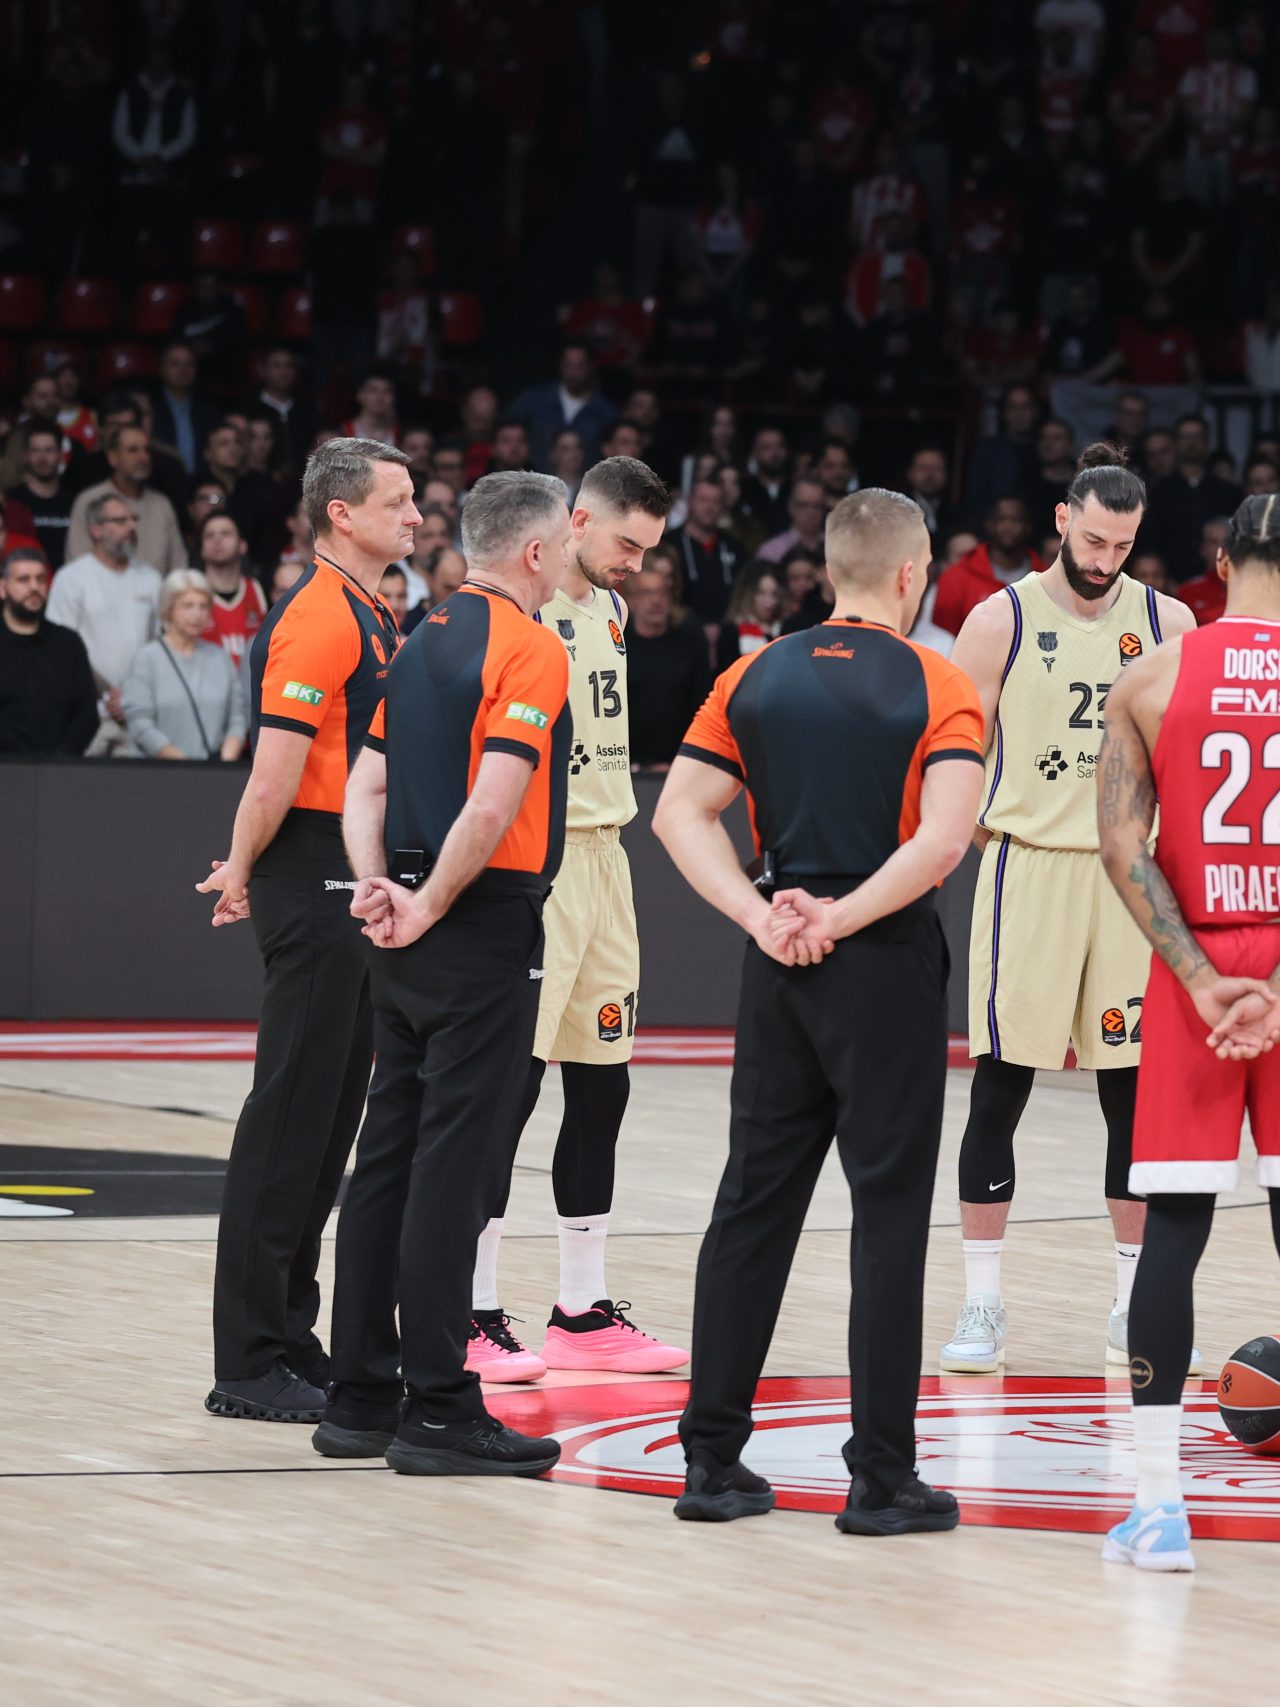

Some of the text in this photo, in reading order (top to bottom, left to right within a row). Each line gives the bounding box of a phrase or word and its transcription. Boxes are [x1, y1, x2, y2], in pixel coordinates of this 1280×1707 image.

[283, 682, 324, 703] BKT
[588, 670, 622, 718] 13
[506, 703, 548, 727] BKT
